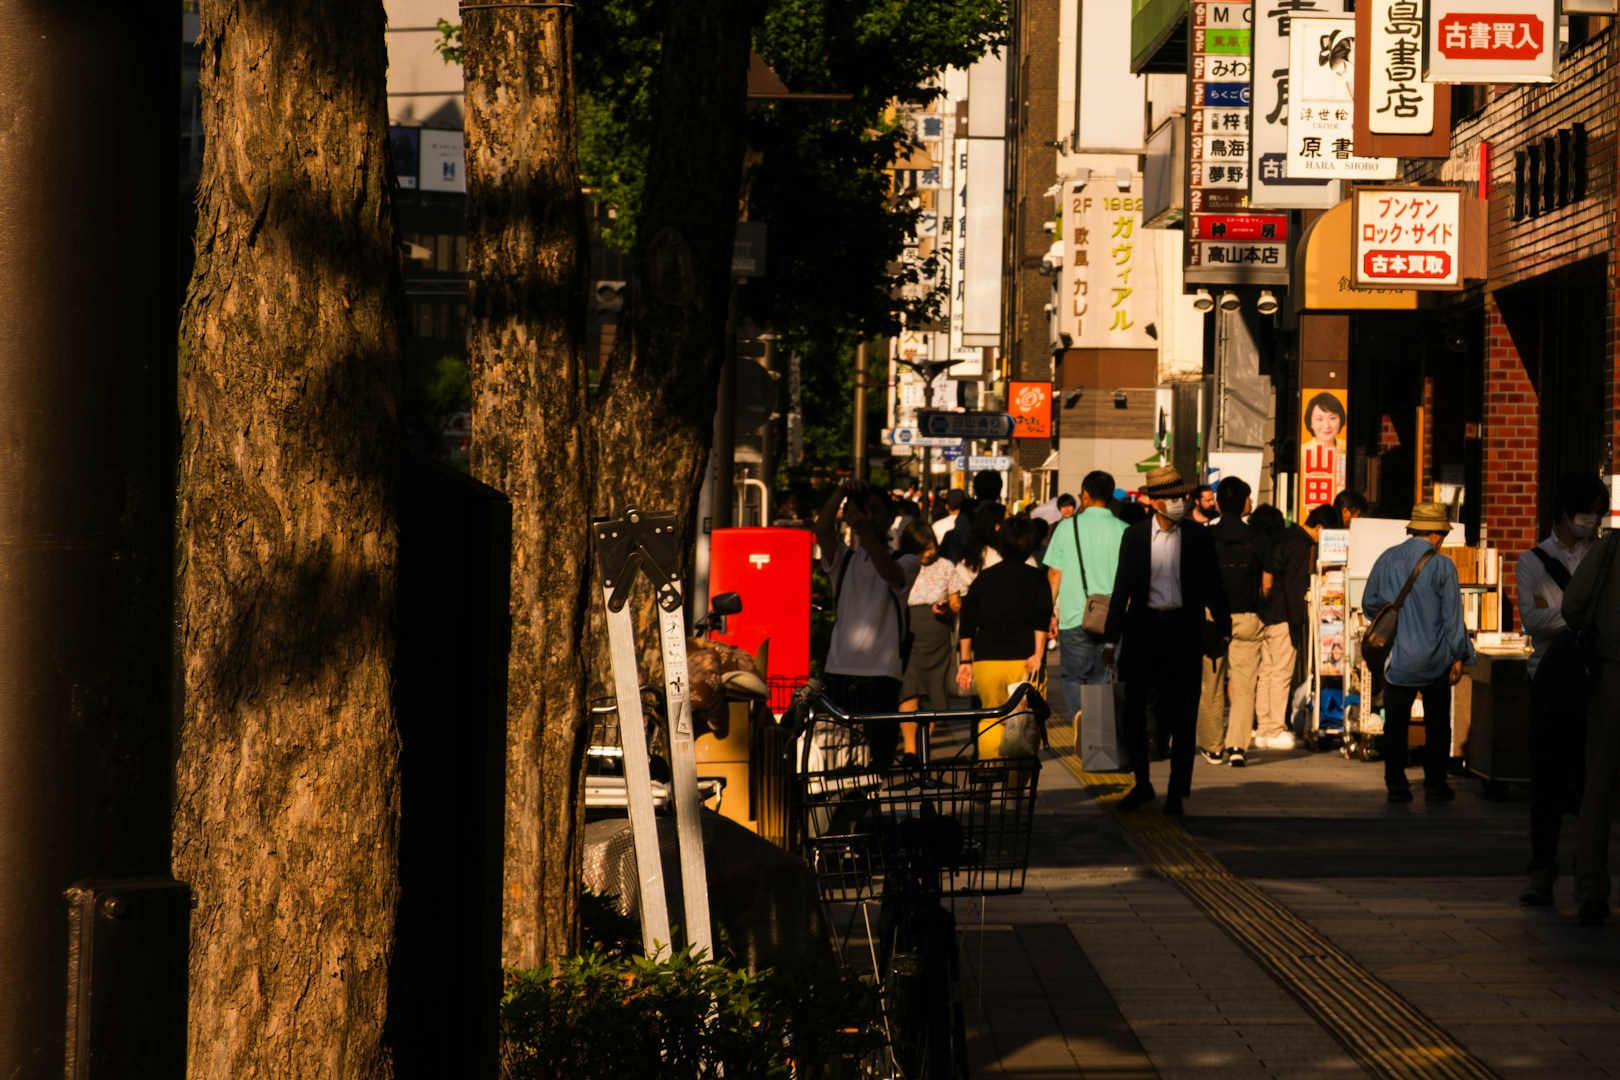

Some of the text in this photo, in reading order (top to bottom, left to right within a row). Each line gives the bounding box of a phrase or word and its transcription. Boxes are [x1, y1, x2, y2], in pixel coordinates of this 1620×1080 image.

[1195, 3, 1205, 26] 6F
[1194, 30, 1204, 52] 5F
[1445, 21, 1539, 50] 古書買入
[1193, 57, 1204, 80] 5F
[1212, 60, 1250, 77] みわ
[1193, 84, 1203, 106] 5F
[1192, 111, 1203, 132] 4F
[1223, 113, 1249, 131] 梓
[1300, 108, 1349, 122] 浮世絵
[1192, 138, 1202, 160] 3F
[1210, 140, 1249, 157] 鳥海
[1192, 163, 1202, 186] 2F
[1209, 166, 1248, 184] 夢野
[1305, 160, 1379, 171] HARA SHOBO
[1072, 198, 1092, 214] 2F
[1191, 190, 1202, 212] 2F
[1379, 197, 1439, 219] ブンケン
[1363, 223, 1453, 245] ロック・サイド
[1208, 245, 1279, 264] 高山本店
[1371, 254, 1444, 274] 古本買取
[1073, 227, 1090, 337] 欧風カレー
[1109, 216, 1134, 331] ガヴィアル
[1304, 444, 1334, 512] 山田
